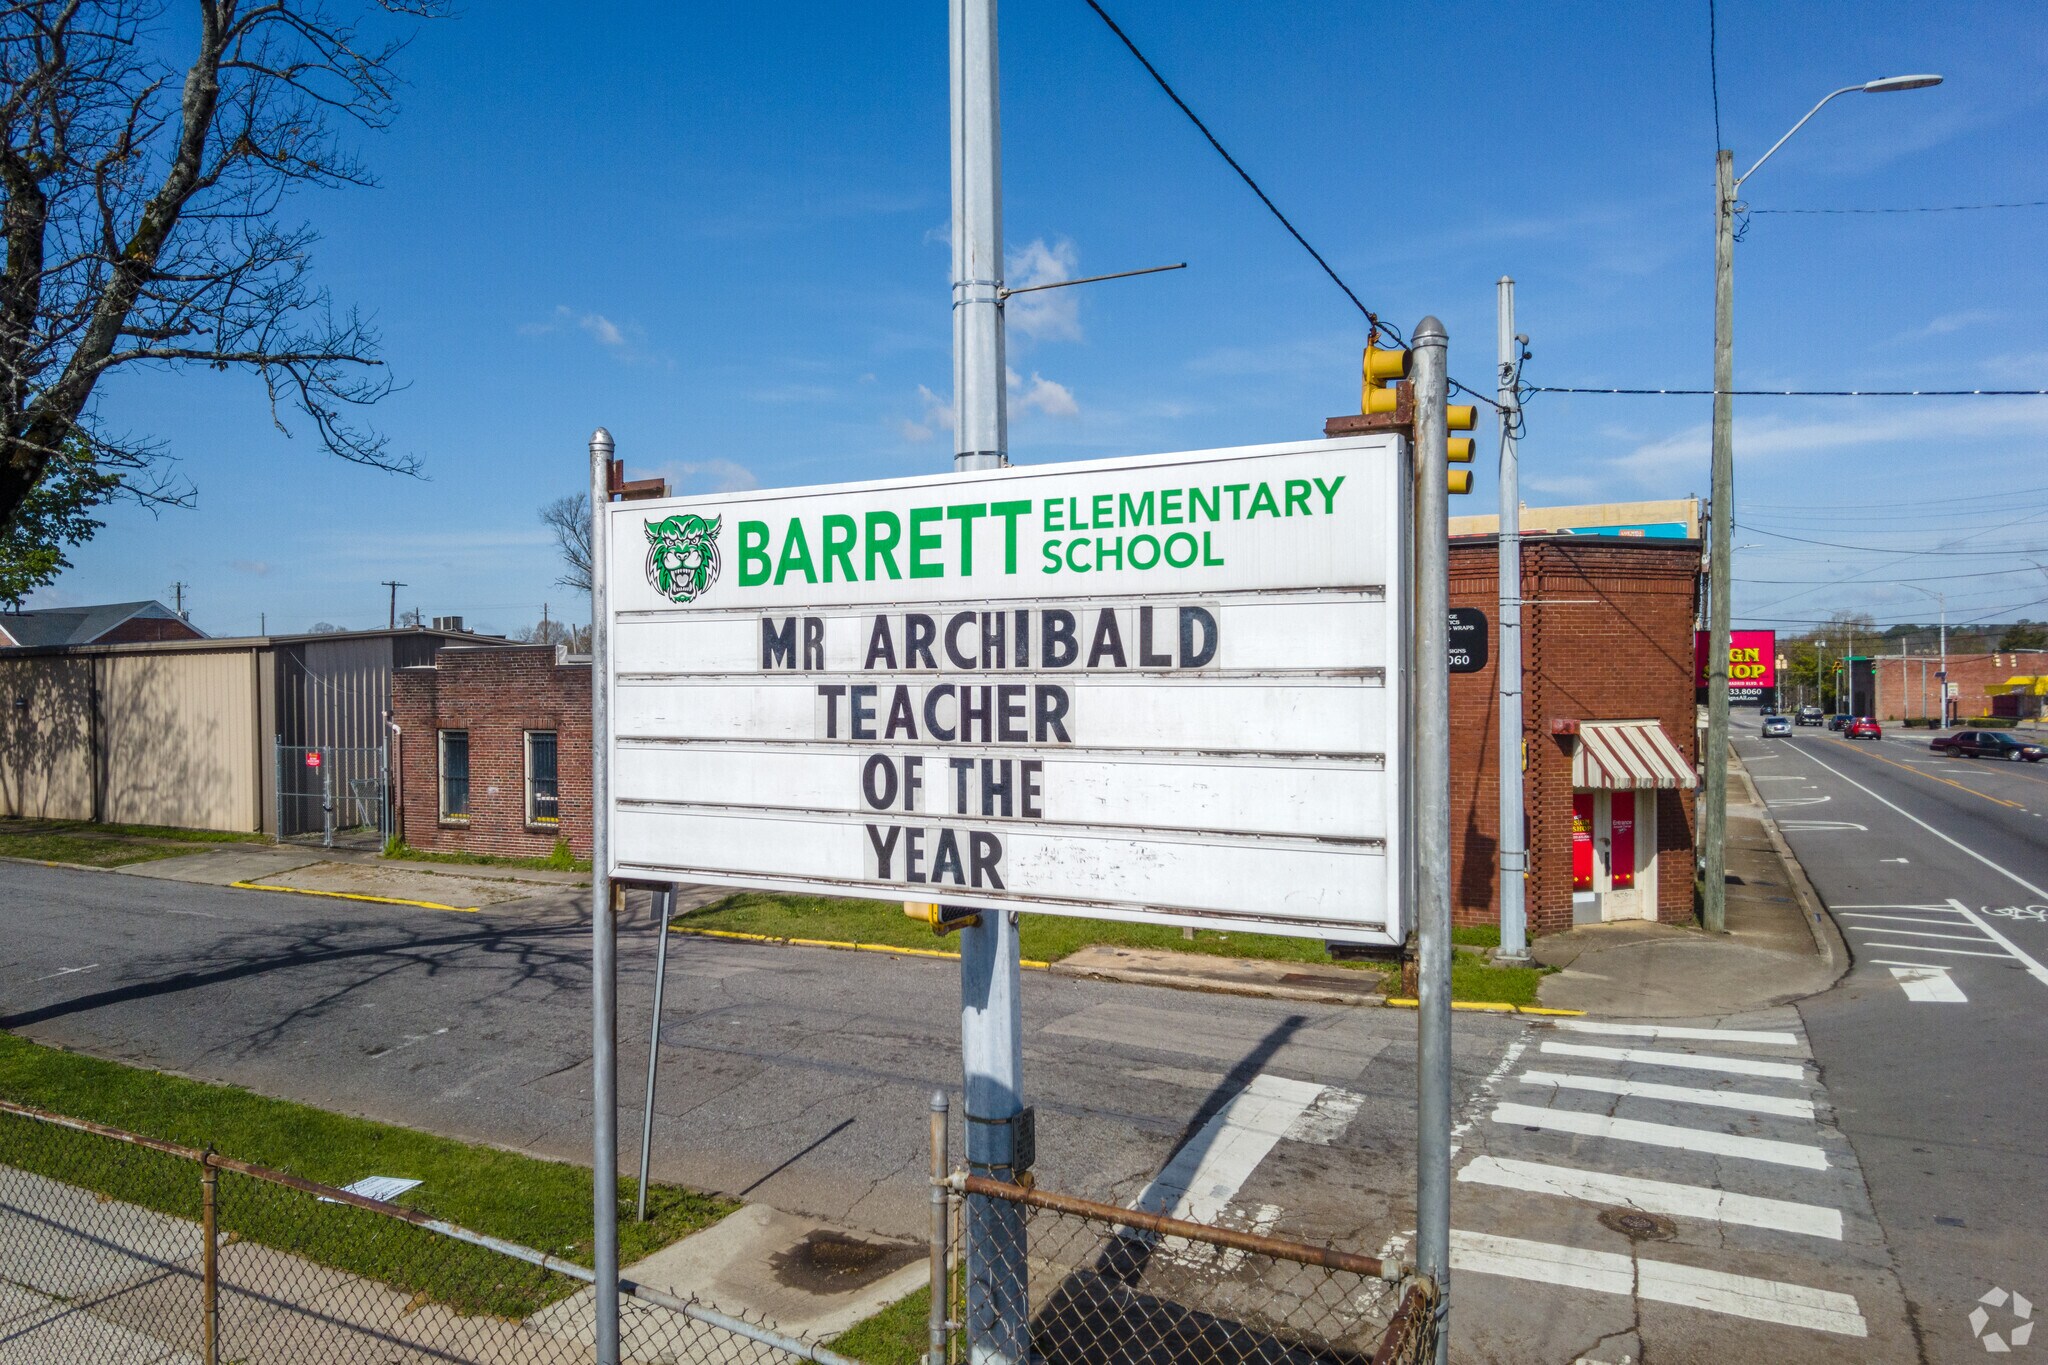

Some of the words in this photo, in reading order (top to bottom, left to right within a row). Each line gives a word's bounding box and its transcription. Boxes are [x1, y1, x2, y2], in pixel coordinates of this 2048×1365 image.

[1043, 475, 1345, 533] ELEMENTARY
[737, 499, 1033, 588] BARRETT
[1042, 530, 1225, 575] SCHOOL
[761, 616, 825, 671] MR
[864, 605, 1218, 670] ARCHIBALD
[1729, 647, 1760, 662] GN
[817, 684, 1072, 743] TEACHER
[862, 753, 923, 812] OF
[949, 757, 1043, 819] THE
[865, 823, 1006, 890] YEAR
